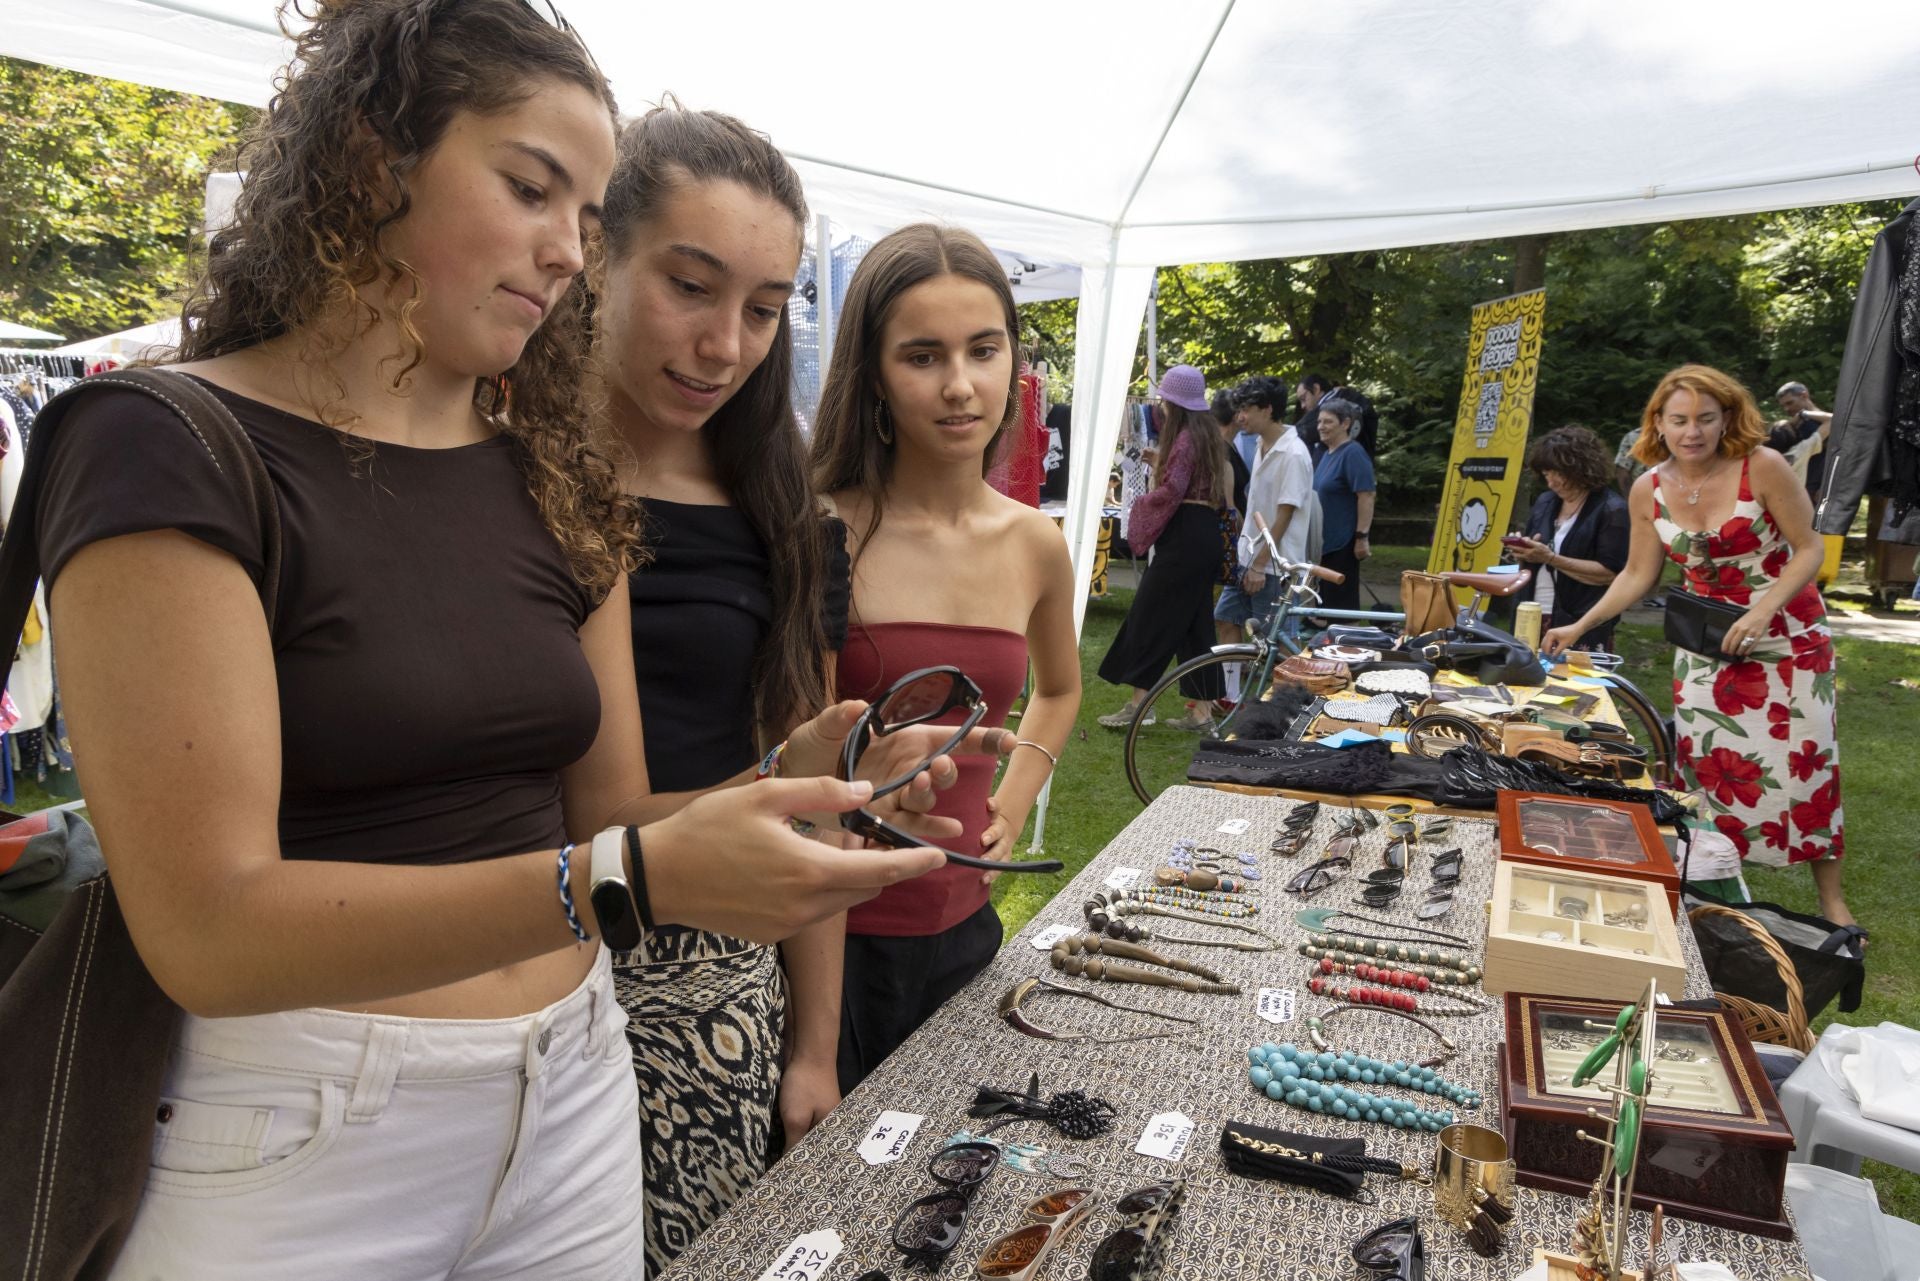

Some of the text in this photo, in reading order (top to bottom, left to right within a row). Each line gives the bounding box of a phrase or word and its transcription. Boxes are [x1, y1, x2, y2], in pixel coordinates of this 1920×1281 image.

[1480, 342, 1517, 374] people
[871, 1126, 893, 1141] 3€
[773, 1246, 807, 1279] GAFAS
